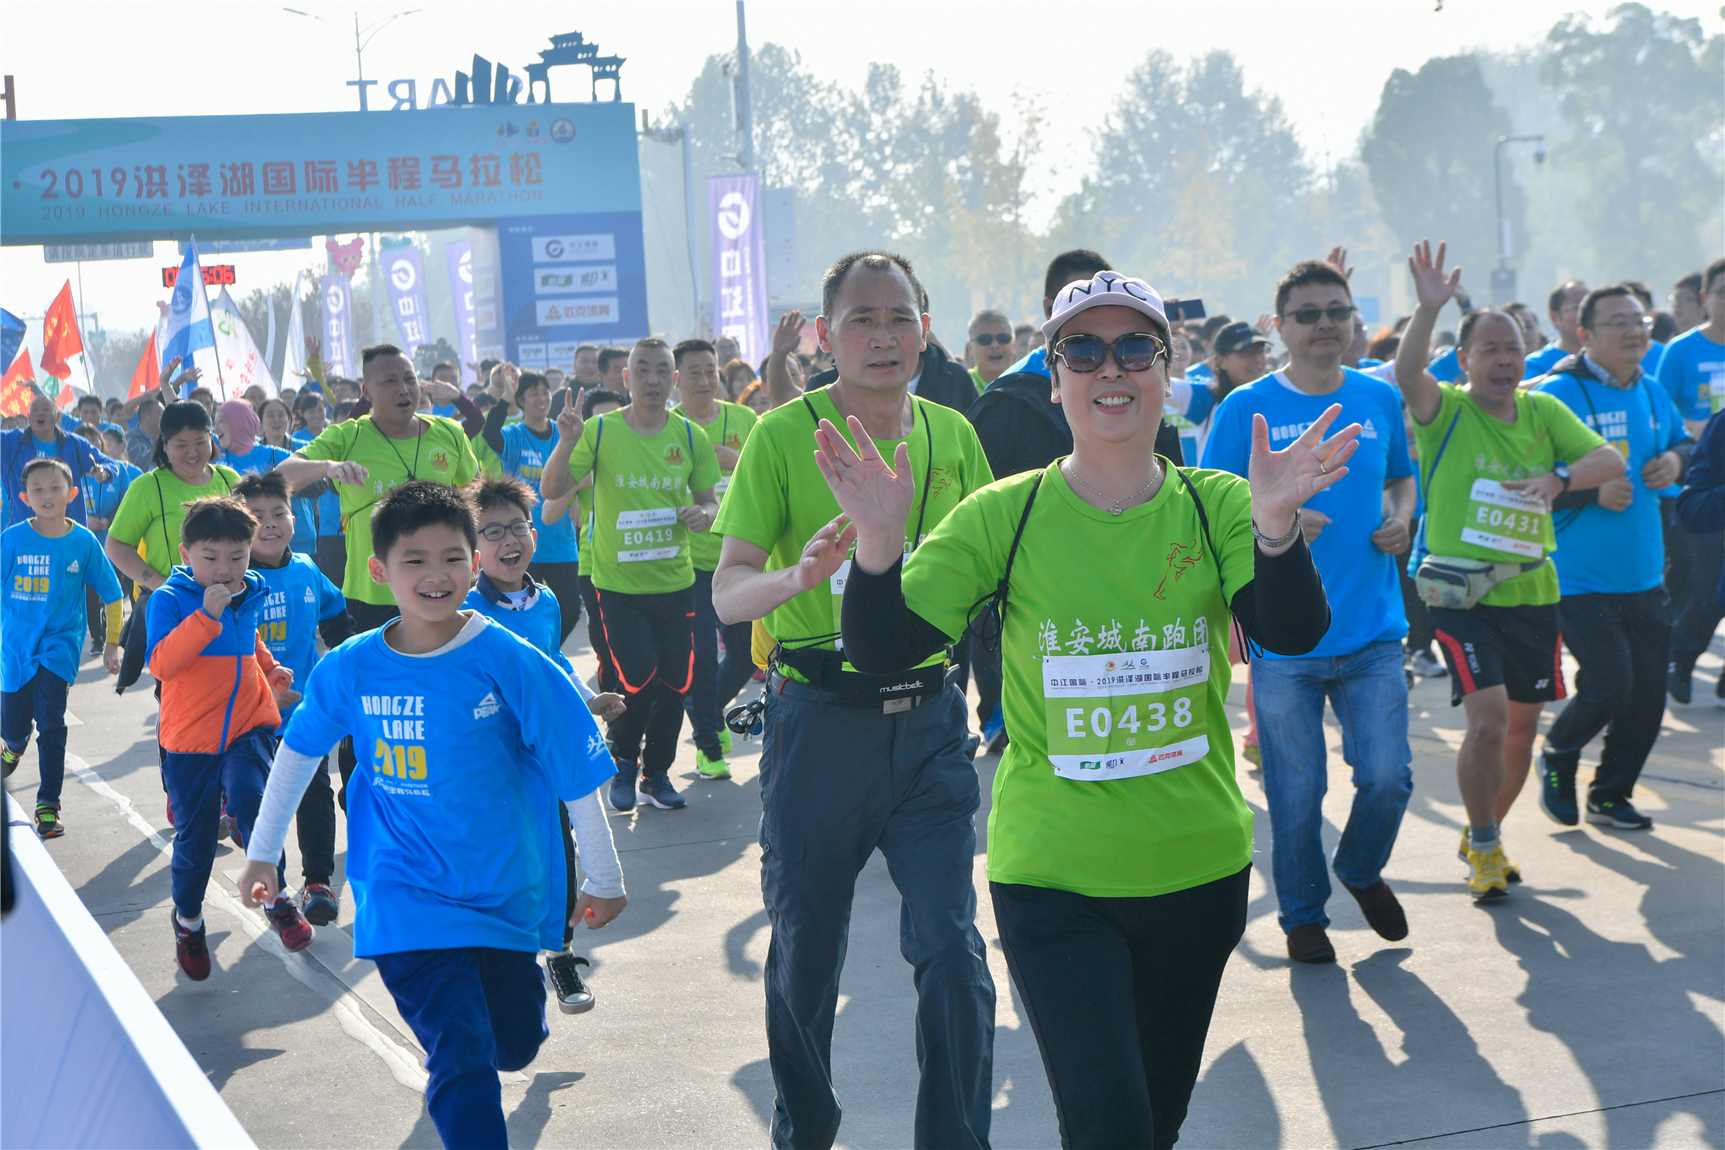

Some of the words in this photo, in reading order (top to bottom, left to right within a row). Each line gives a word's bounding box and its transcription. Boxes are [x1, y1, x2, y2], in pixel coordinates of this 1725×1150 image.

[40, 151, 543, 200] 2019洪泽湖国际半程马拉松
[43, 206, 86, 220] 2019
[99, 202, 173, 218] HONGZE
[187, 201, 231, 216] LAKE
[244, 195, 382, 214] INTERNATIONAL
[395, 193, 437, 208] HALF
[451, 189, 543, 205] MARATHON
[1069, 276, 1147, 303] NYC
[1476, 507, 1540, 535] E0431
[624, 528, 673, 545] E0419
[28, 565, 50, 576] LAKE
[14, 575, 50, 593] 2019
[264, 605, 286, 621] LAKE
[258, 621, 287, 643] 019
[1038, 615, 1209, 656] 淮安城南跑团
[361, 696, 424, 716] HONGZE
[473, 704, 502, 720] PEAK
[1066, 697, 1192, 738] E0438
[382, 719, 425, 740] LAKE
[374, 738, 427, 780] 2019
